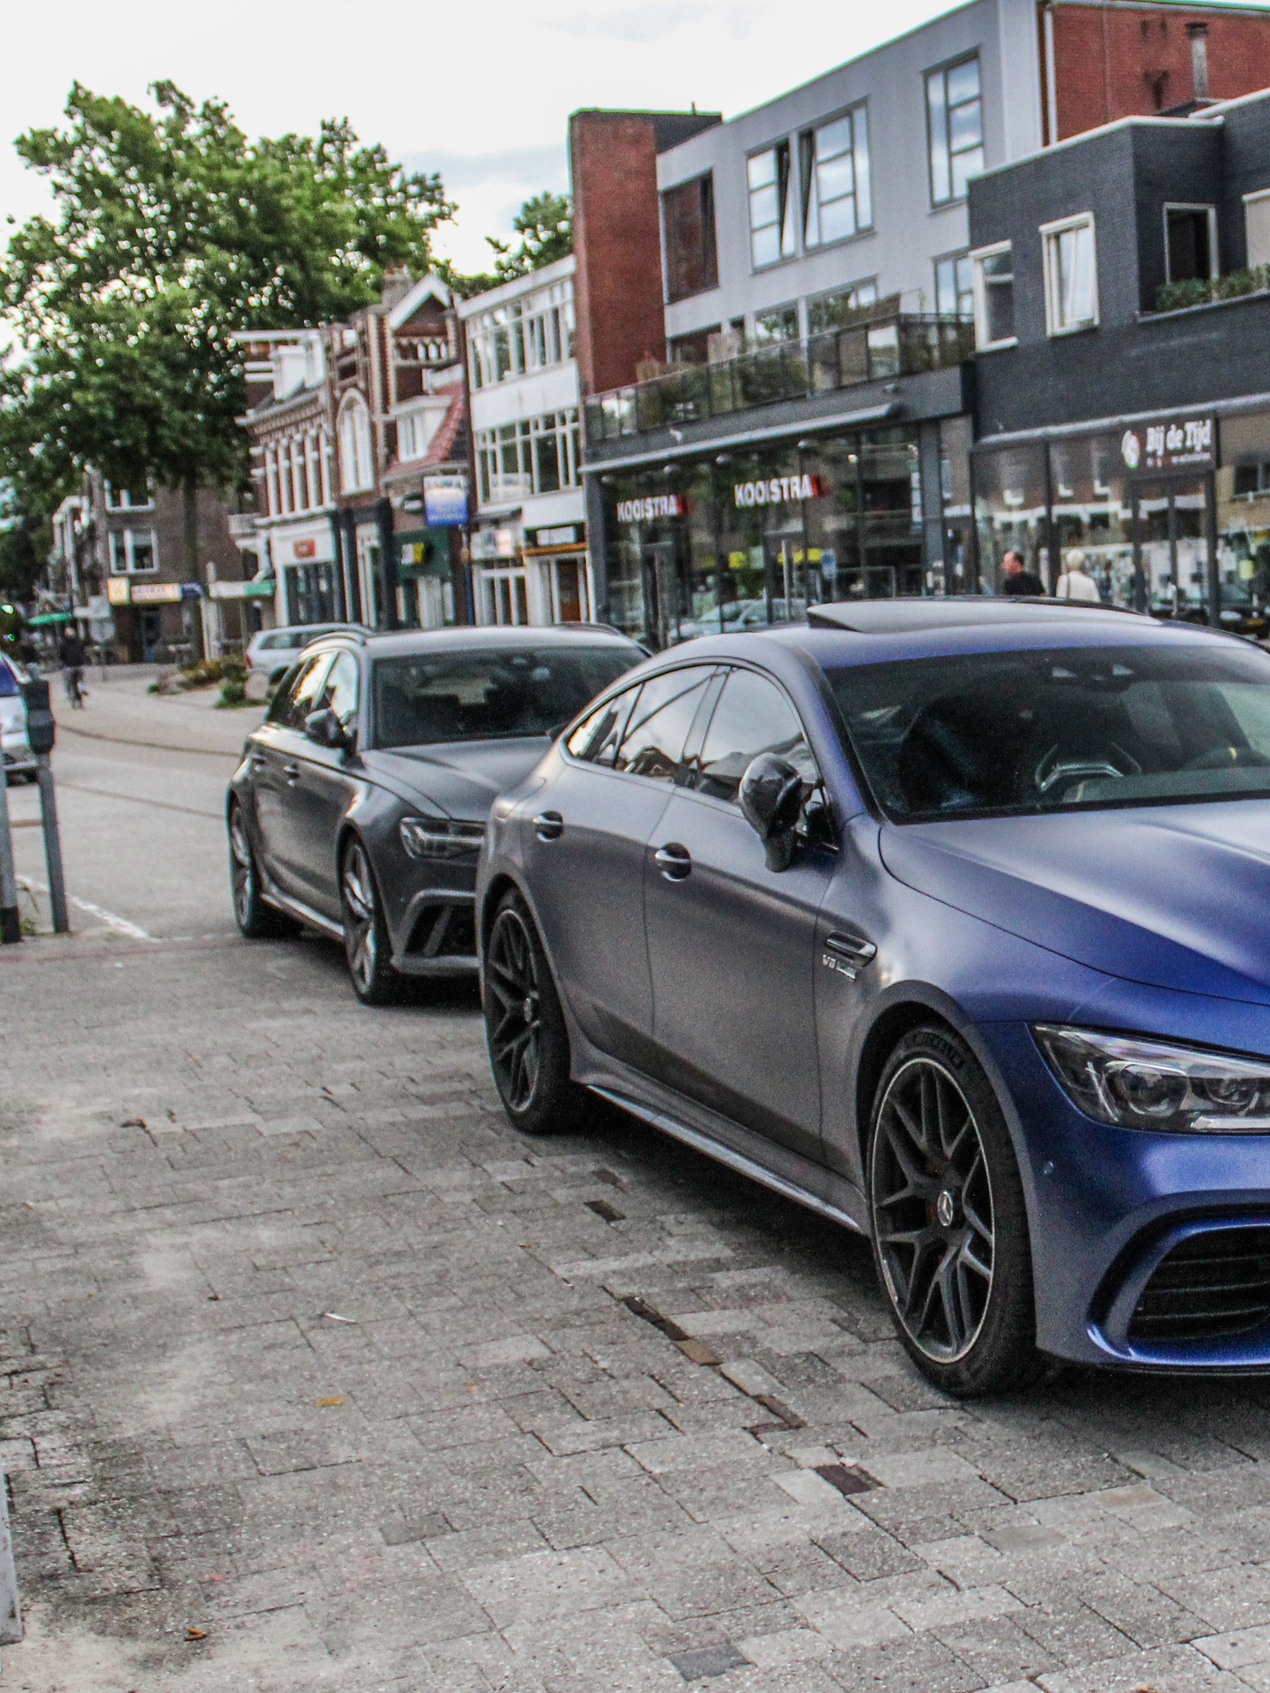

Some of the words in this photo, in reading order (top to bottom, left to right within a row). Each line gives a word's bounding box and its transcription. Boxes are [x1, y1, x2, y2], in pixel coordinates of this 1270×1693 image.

[1145, 425, 1165, 457] Bij
[1165, 423, 1184, 450] de
[1184, 419, 1211, 452] Tijd
[616, 494, 680, 522] KOOISTRA
[734, 474, 814, 508] KOOISTRA
